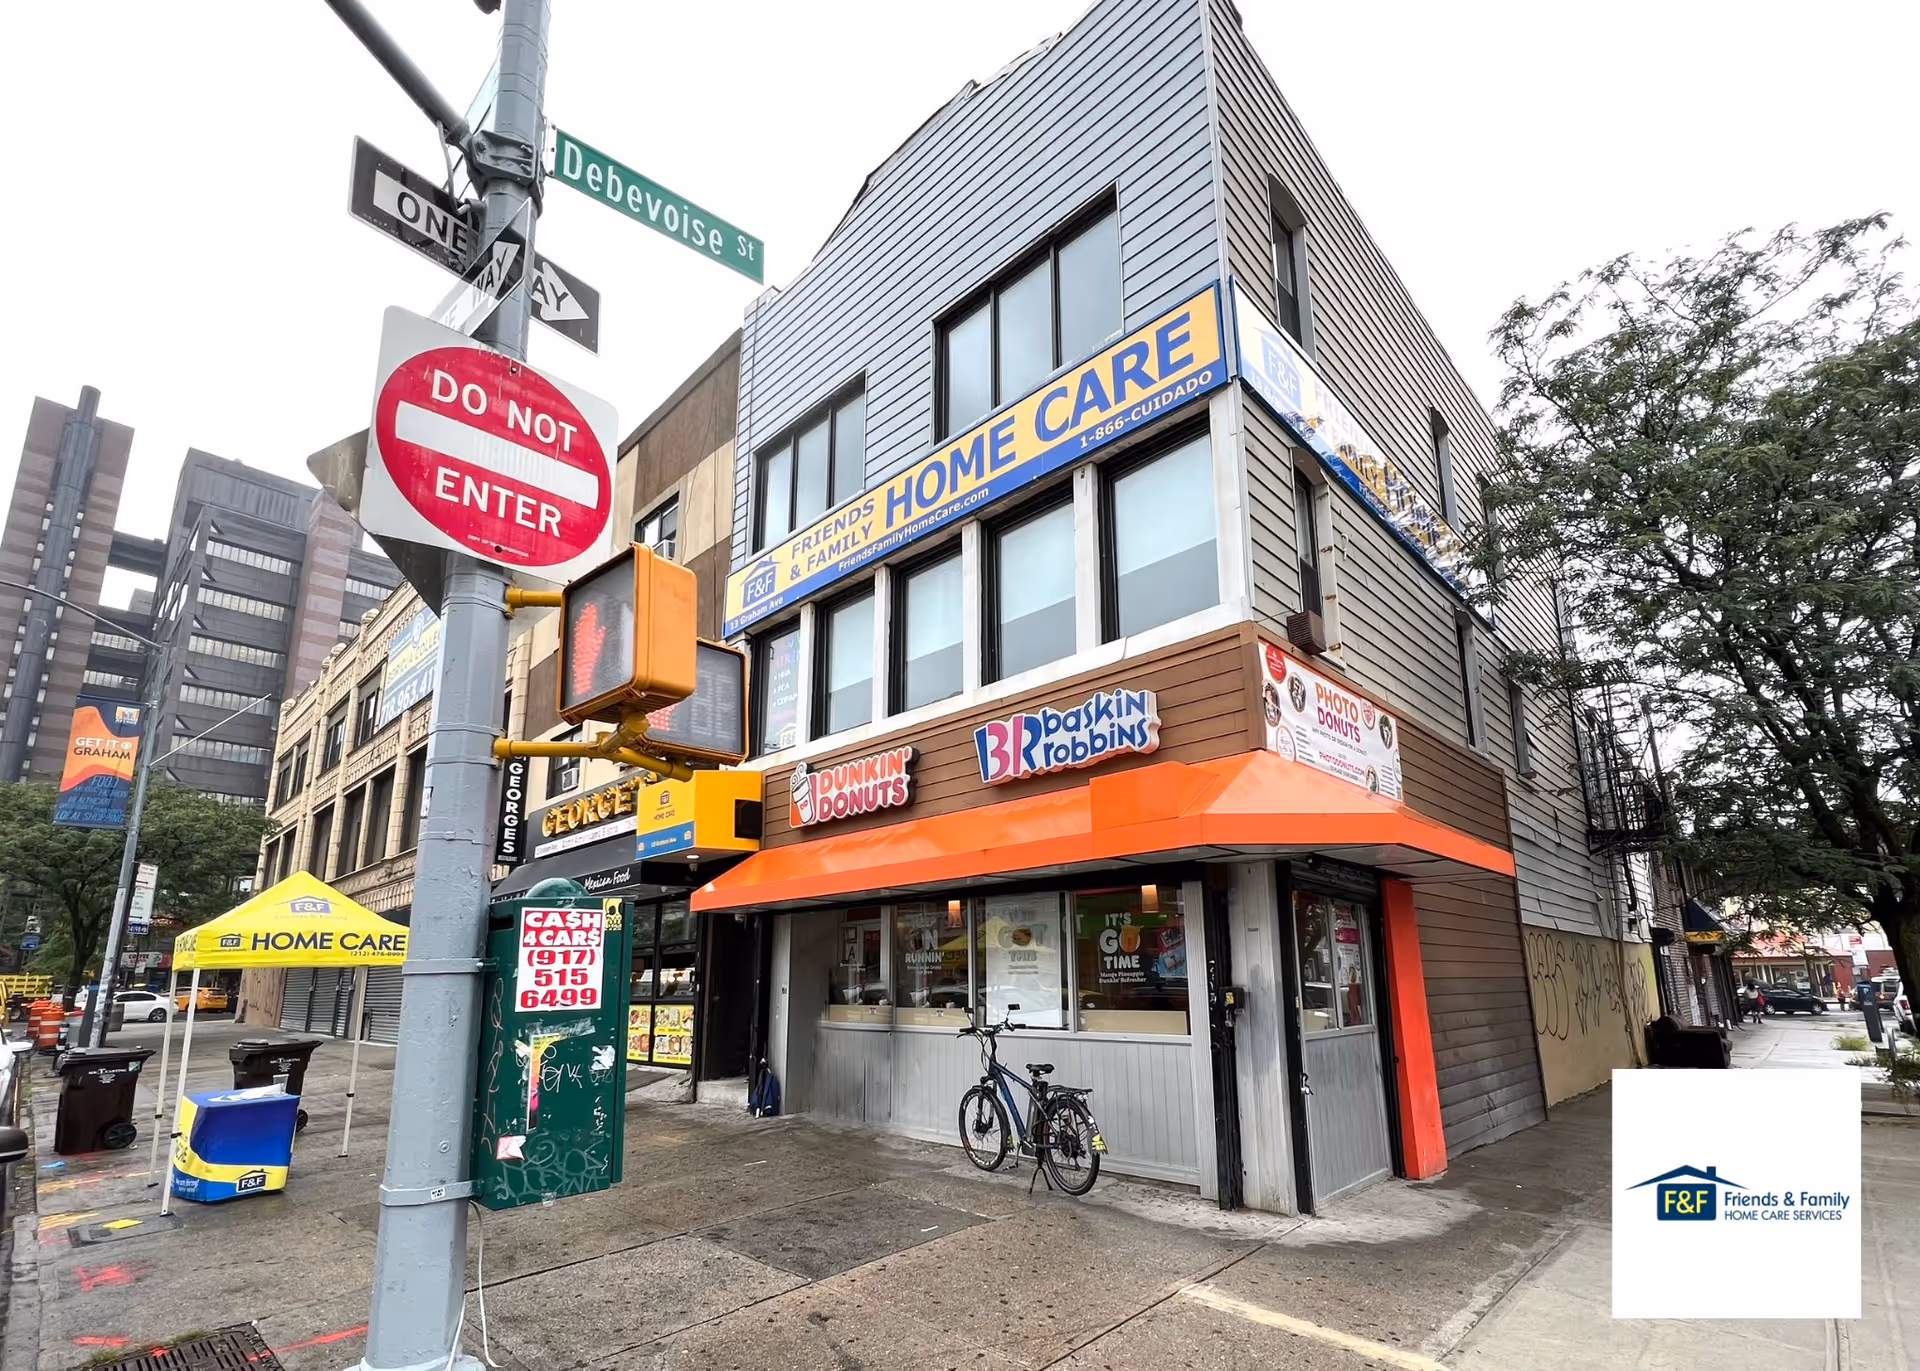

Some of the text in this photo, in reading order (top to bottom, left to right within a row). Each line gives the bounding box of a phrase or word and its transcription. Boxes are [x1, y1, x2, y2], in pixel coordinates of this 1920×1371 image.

[562, 139, 755, 262] Debevoise St
[397, 191, 468, 254] ONE
[532, 274, 570, 313] AY
[431, 368, 578, 453] DO NOT
[885, 414, 1016, 530] HOME
[1034, 311, 1195, 443] CARE
[1079, 369, 1213, 450] 1-866-CUIDADO
[434, 465, 562, 539] ENTER
[791, 497, 876, 560] FRIENDS
[837, 487, 990, 573] FriendsFamilyHomeCare.com
[789, 521, 874, 581] & FAMILY
[747, 569, 774, 599] F&F
[730, 595, 784, 631] 13 Graham Ave
[1041, 688, 1146, 738] baskin
[1315, 681, 1359, 724] PHOTO
[75, 736, 104, 748] GET
[105, 739, 120, 749] IT
[1043, 717, 1148, 768] robbins
[1317, 706, 1361, 744] DONUTS
[73, 746, 131, 760] GRAHAM
[975, 714, 1043, 782] BR
[819, 747, 910, 795] DUNKIN'
[502, 762, 524, 854] GEORGES
[819, 776, 905, 820] DONUTS
[583, 867, 632, 891] Mexican Food
[294, 901, 326, 913] F&F
[525, 910, 601, 930] CA$H
[1104, 912, 1132, 927] IT'S
[221, 931, 406, 951] F&F HOME CARE
[527, 949, 596, 967] (917)
[904, 951, 945, 963] RUNNIN'
[534, 968, 588, 987] 515
[1103, 955, 1141, 970] TIME
[520, 987, 598, 1009] 6499
[241, 1176, 264, 1188] F&F
